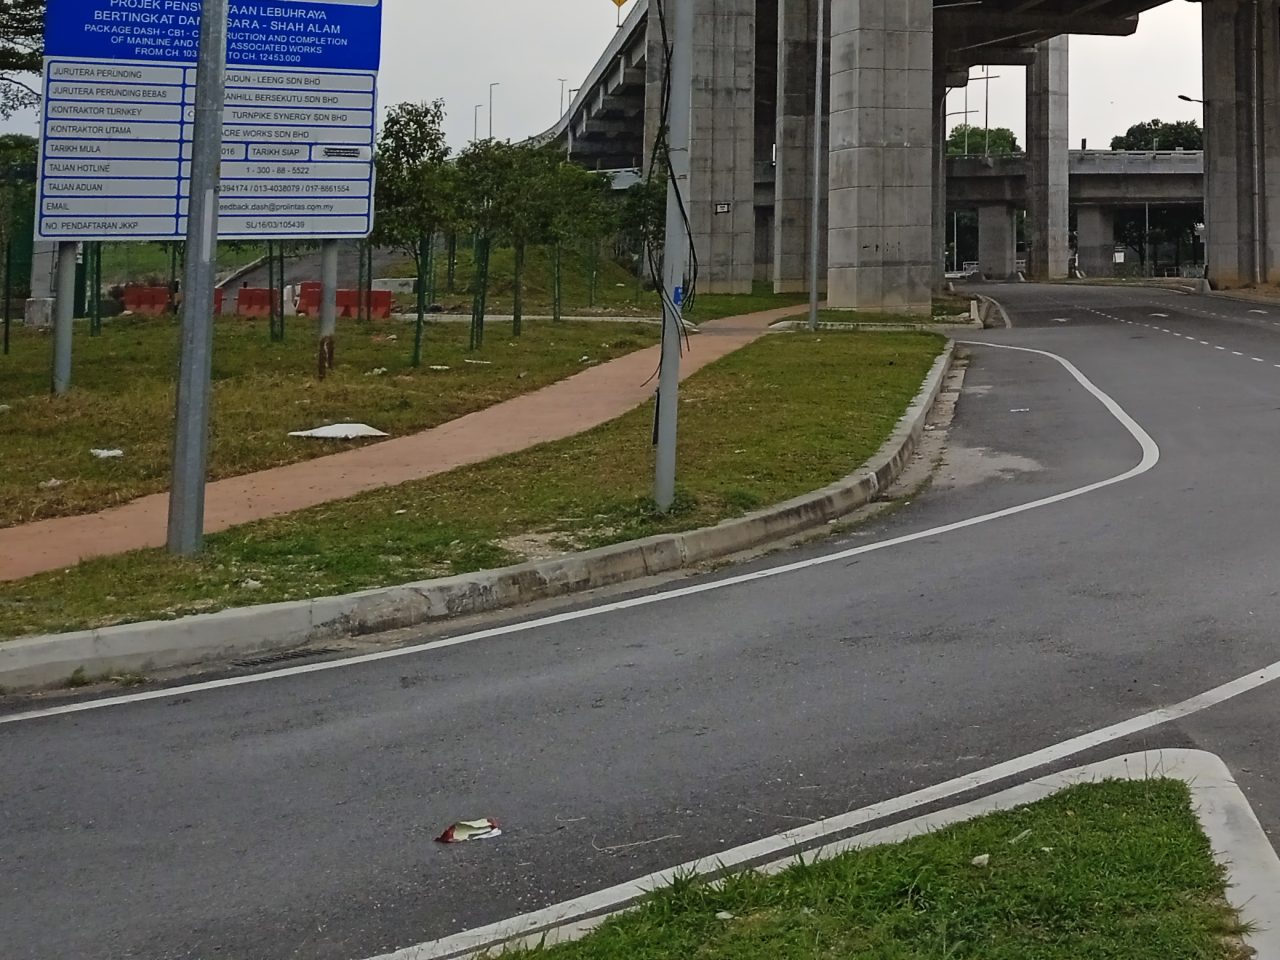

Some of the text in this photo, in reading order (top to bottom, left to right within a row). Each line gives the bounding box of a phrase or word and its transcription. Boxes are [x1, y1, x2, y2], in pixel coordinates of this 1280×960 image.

[260, 7, 327, 20] LEBUHRAYA
[94, 10, 175, 24] BERTINGKAT
[270, 20, 304, 32] SHAH
[306, 23, 341, 34] ALAM
[84, 24, 132, 34] PACKAGE
[133, 26, 160, 35] DASH
[167, 28, 185, 37] CB1
[267, 35, 288, 43] AND
[289, 36, 348, 46] COMPLETION
[111, 35, 124, 44] OF
[127, 36, 171, 46] MAINLINE
[173, 39, 193, 47] AND
[230, 42, 288, 52] ASSOCIATED
[289, 45, 323, 54] WORKS
[135, 47, 163, 56] FROM
[229, 52, 241, 60] TO
[54, 67, 142, 79] JURUTERA PERUNDING
[286, 76, 303, 85] SDN
[304, 77, 321, 86] BHD
[53, 86, 167, 98] JURUTERA PERUNDING BEBAS
[254, 94, 303, 103] BERSEKUTU
[304, 95, 321, 103] SDN
[322, 96, 339, 104] BHD
[51, 105, 143, 117] KONTRAKTOR TURNKEY
[232, 111, 348, 122] TURNPIKE SYNERGY SDN BHD
[50, 124, 132, 134] KONTRAKTOR UTAMA
[242, 129, 273, 137] WORKS
[274, 130, 291, 138] SDN
[50, 144, 101, 153] TARIKH MULA
[252, 148, 300, 156] TARIKH SIAP
[49, 163, 111, 173] TALIAN HOTLINE
[48, 183, 103, 192] TALIAN ADUAN
[46, 202, 70, 211] EMAIL
[61, 222, 118, 230] PENDAFTARAN
